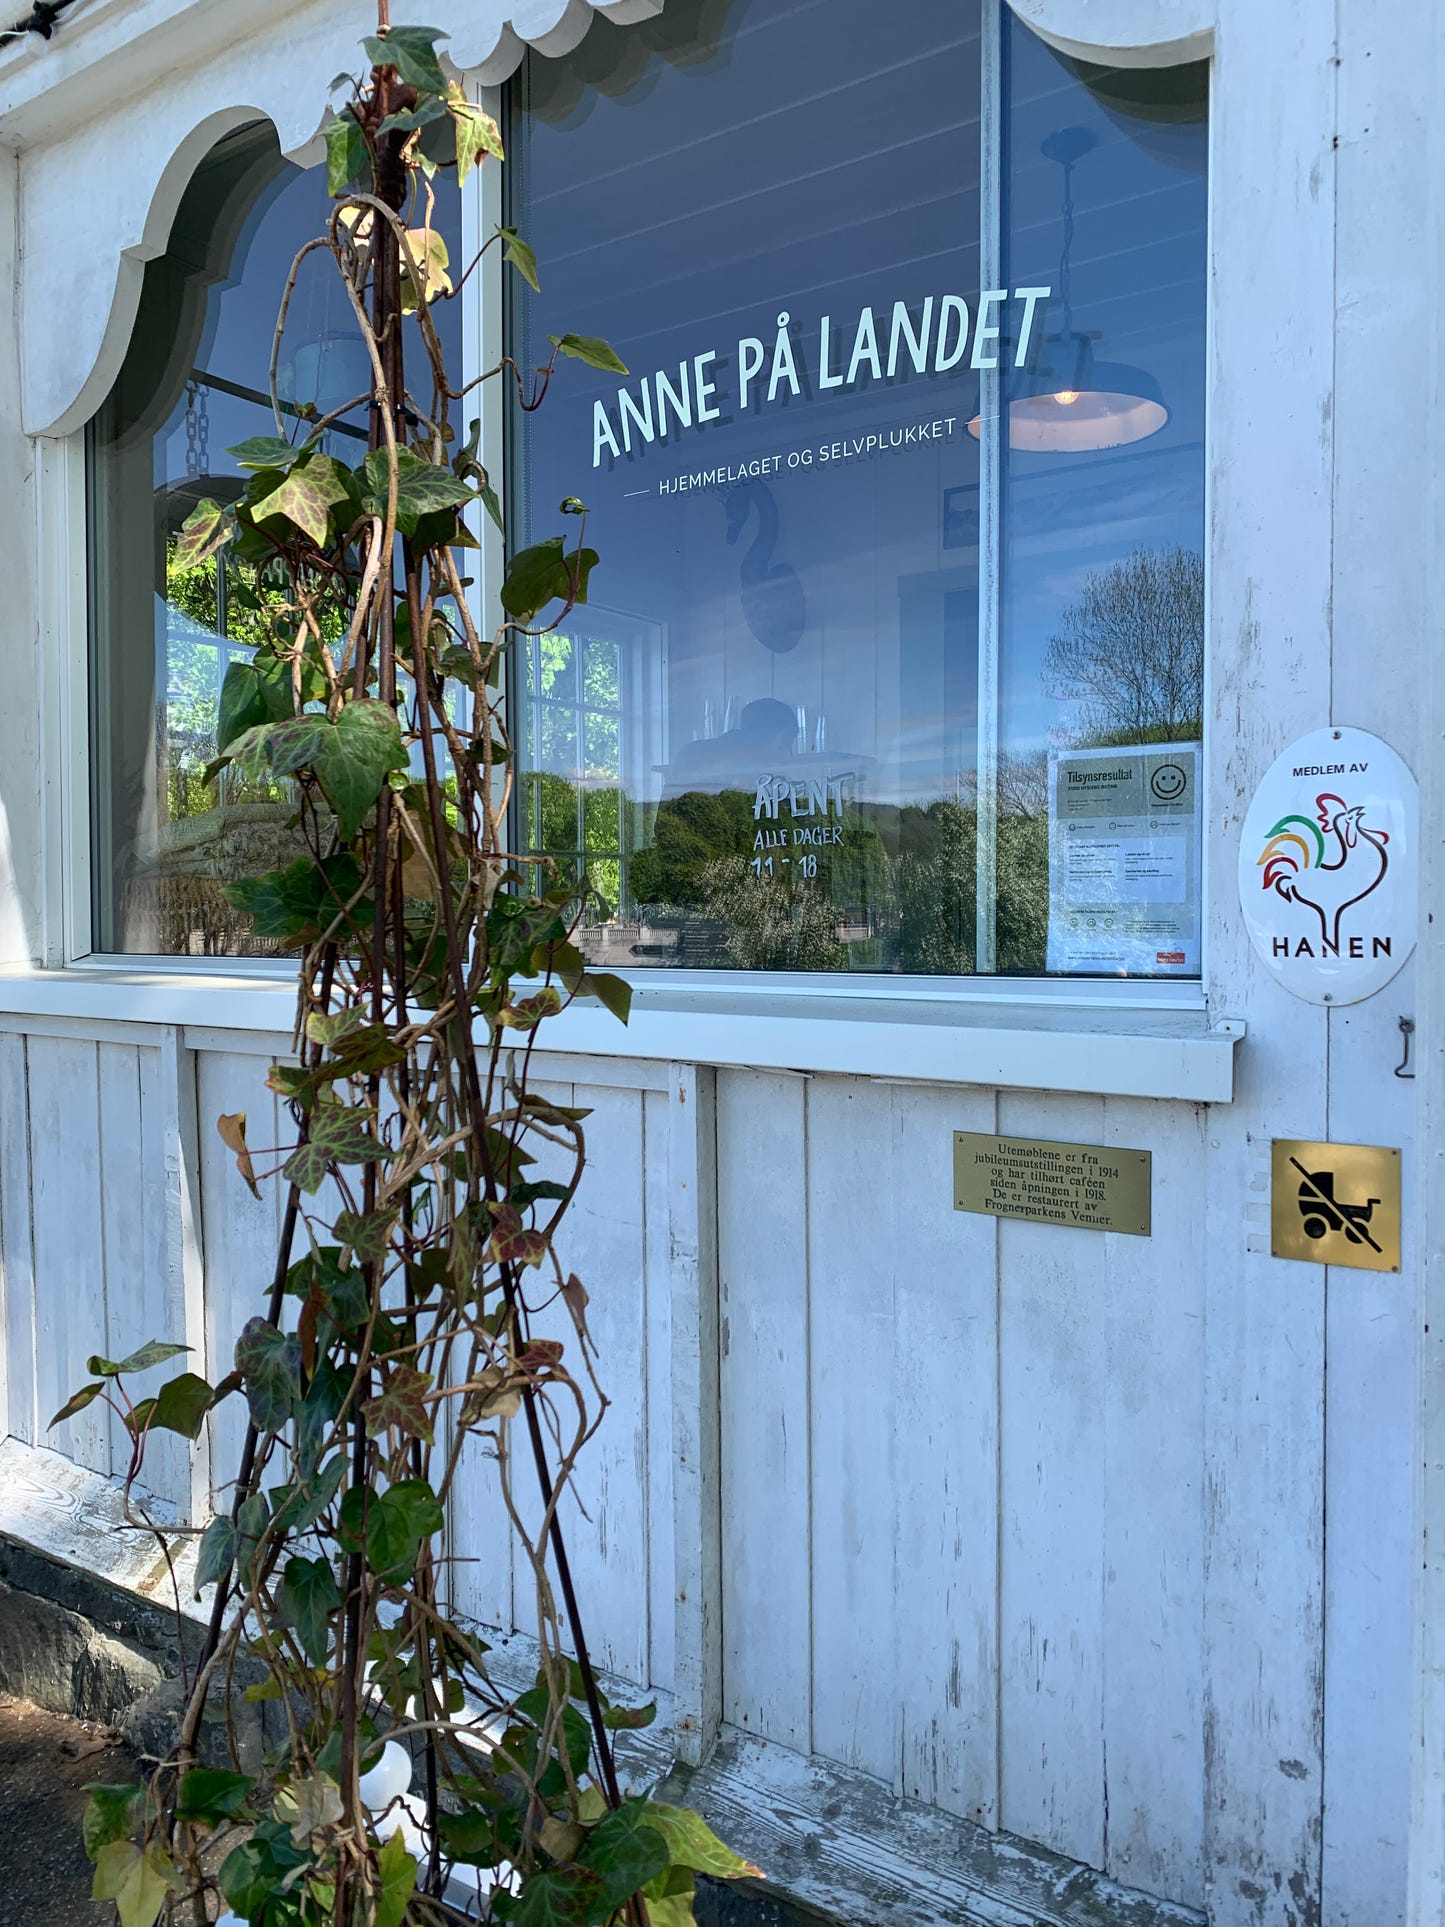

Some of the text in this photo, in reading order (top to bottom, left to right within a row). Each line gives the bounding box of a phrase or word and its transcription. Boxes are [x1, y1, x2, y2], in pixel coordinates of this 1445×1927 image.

[593, 286, 1052, 467] ANNE PÅ LANDET
[659, 418, 957, 495] HJEMMELAGET OG SELVPLUKKET
[1067, 769, 1133, 785] Tilsynsresultat
[1292, 763, 1368, 777] MEDLEM AV
[752, 772, 855, 820] ÅPENT
[753, 826, 844, 851] ALLE DAGER
[751, 856, 773, 878] 11
[799, 854, 817, 877] 18
[1273, 937, 1391, 958] HANEN
[974, 1152, 1119, 1178] jubileumsutstillingen i 1914
[998, 1144, 1098, 1164] Utemøblene er fra
[990, 1178, 1106, 1201] siden åpningen i 1918.
[991, 1168, 1105, 1189] og har tilhørt caféen
[984, 1199, 1066, 1219] Frognerparkens
[993, 1188, 1098, 1211] De er restaurert av
